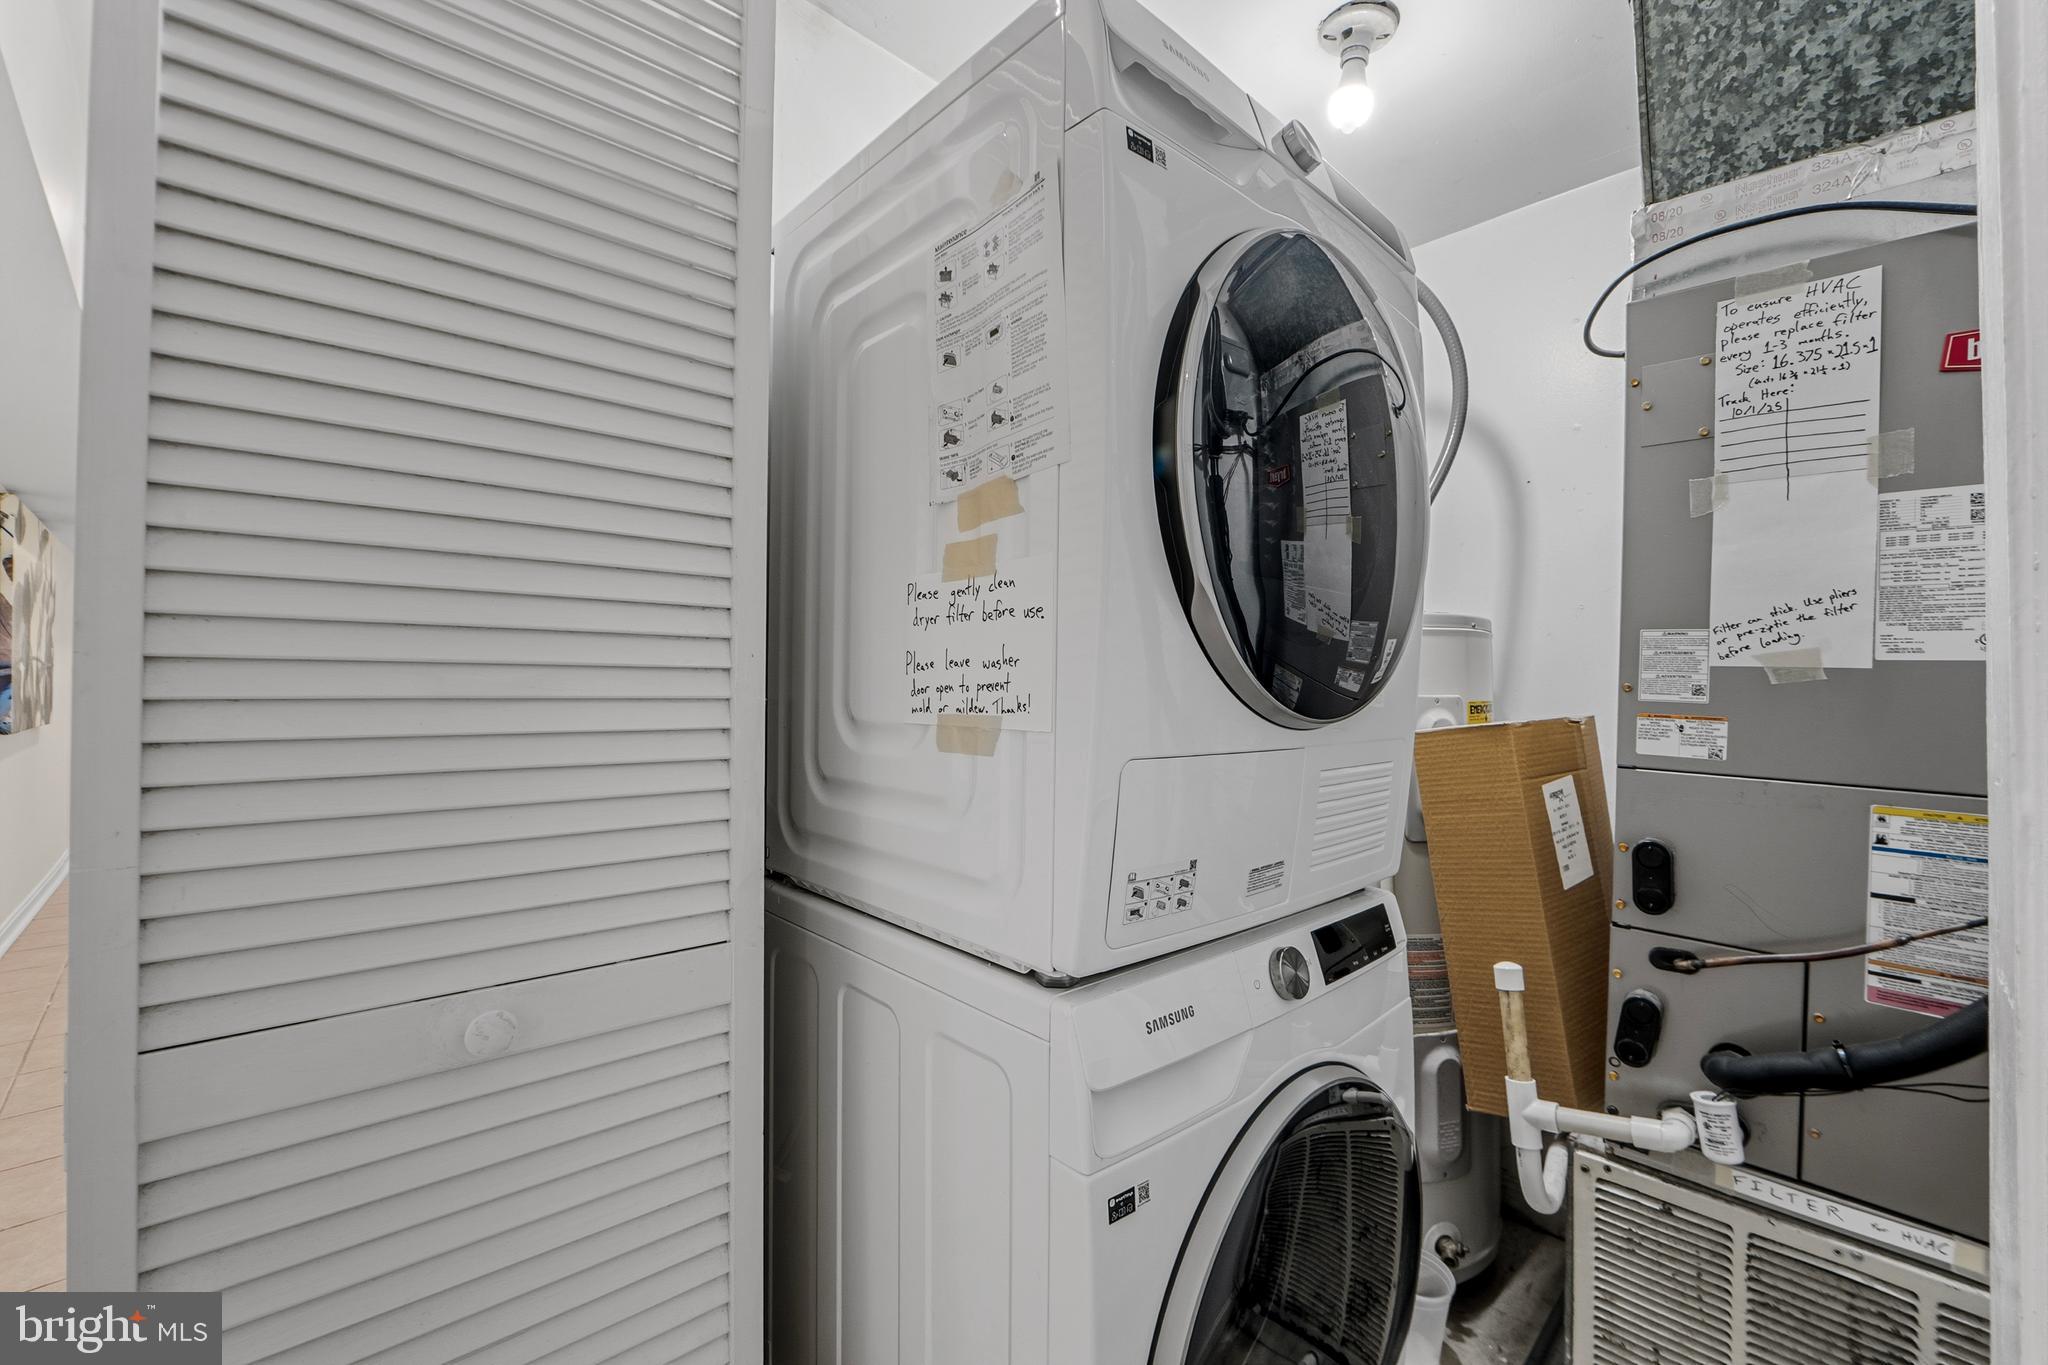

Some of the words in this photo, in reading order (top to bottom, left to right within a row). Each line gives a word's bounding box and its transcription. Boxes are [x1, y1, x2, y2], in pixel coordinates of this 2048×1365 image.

[1161, 38, 1210, 83] SAMSUNG
[1810, 174, 1852, 195] 324A
[1650, 206, 1683, 223] 08/20
[1651, 226, 1684, 244] 08/20
[1721, 301, 1738, 317] To
[1747, 295, 1792, 312] ensure
[1806, 275, 1862, 298] HVAC
[1723, 311, 1781, 335] operates
[1793, 291, 1868, 319] efficiently,
[1720, 331, 1760, 352] please
[1774, 320, 1824, 339] replace
[1832, 310, 1878, 326] filter
[1720, 350, 1752, 363] every
[1763, 340, 1788, 355] 1-3
[1798, 328, 1850, 346] months.
[1735, 359, 1765, 376] Size:
[1718, 391, 1751, 407] Track
[1761, 384, 1795, 400] Here:
[1732, 401, 1782, 419] 10/1/25
[907, 581, 939, 606] Please
[950, 575, 981, 609] gently
[988, 570, 1016, 593] clean
[912, 607, 940, 631] dryer
[946, 601, 975, 626] filter
[982, 600, 1016, 622] before
[1023, 606, 1045, 620] use.
[1712, 622, 1742, 635] Filter
[1803, 598, 1824, 607] Use
[1829, 589, 1857, 605] pliers
[1717, 637, 1728, 646] or
[1796, 613, 1817, 623] the
[1824, 603, 1858, 617] filter
[905, 650, 935, 676] Please
[945, 648, 970, 670] leave
[982, 643, 1021, 671] washer
[1717, 644, 1751, 661] before
[910, 678, 930, 697] door
[935, 684, 954, 702] open
[959, 673, 970, 694] to
[976, 672, 1012, 702] prevent
[911, 697, 932, 714] mold
[938, 704, 950, 714] or
[955, 697, 989, 715] mildew.
[992, 693, 1031, 715] Thanks!
[1145, 1005, 1195, 1035] SAMSUNG
[1733, 1175, 1844, 1222] FILTER
[1902, 1231, 1950, 1256] HVAC
